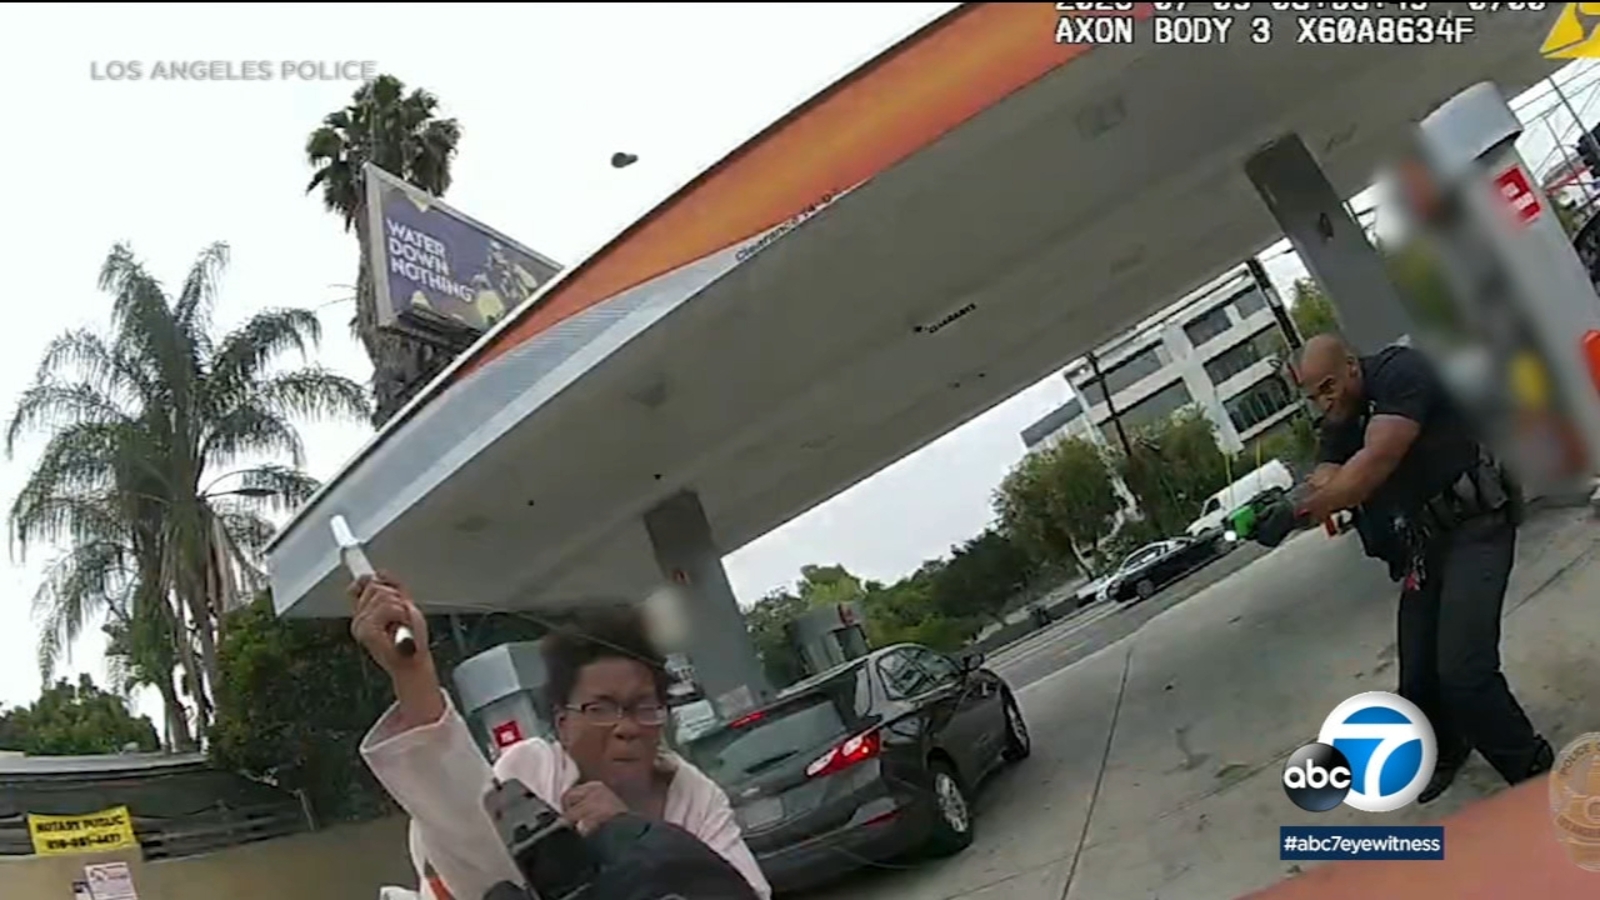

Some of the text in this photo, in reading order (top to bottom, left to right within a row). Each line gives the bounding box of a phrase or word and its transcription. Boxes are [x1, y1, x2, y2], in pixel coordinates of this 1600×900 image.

[387, 219, 445, 257] WATER
[389, 237, 449, 276] DOWN
[391, 257, 475, 303] NOTHING
